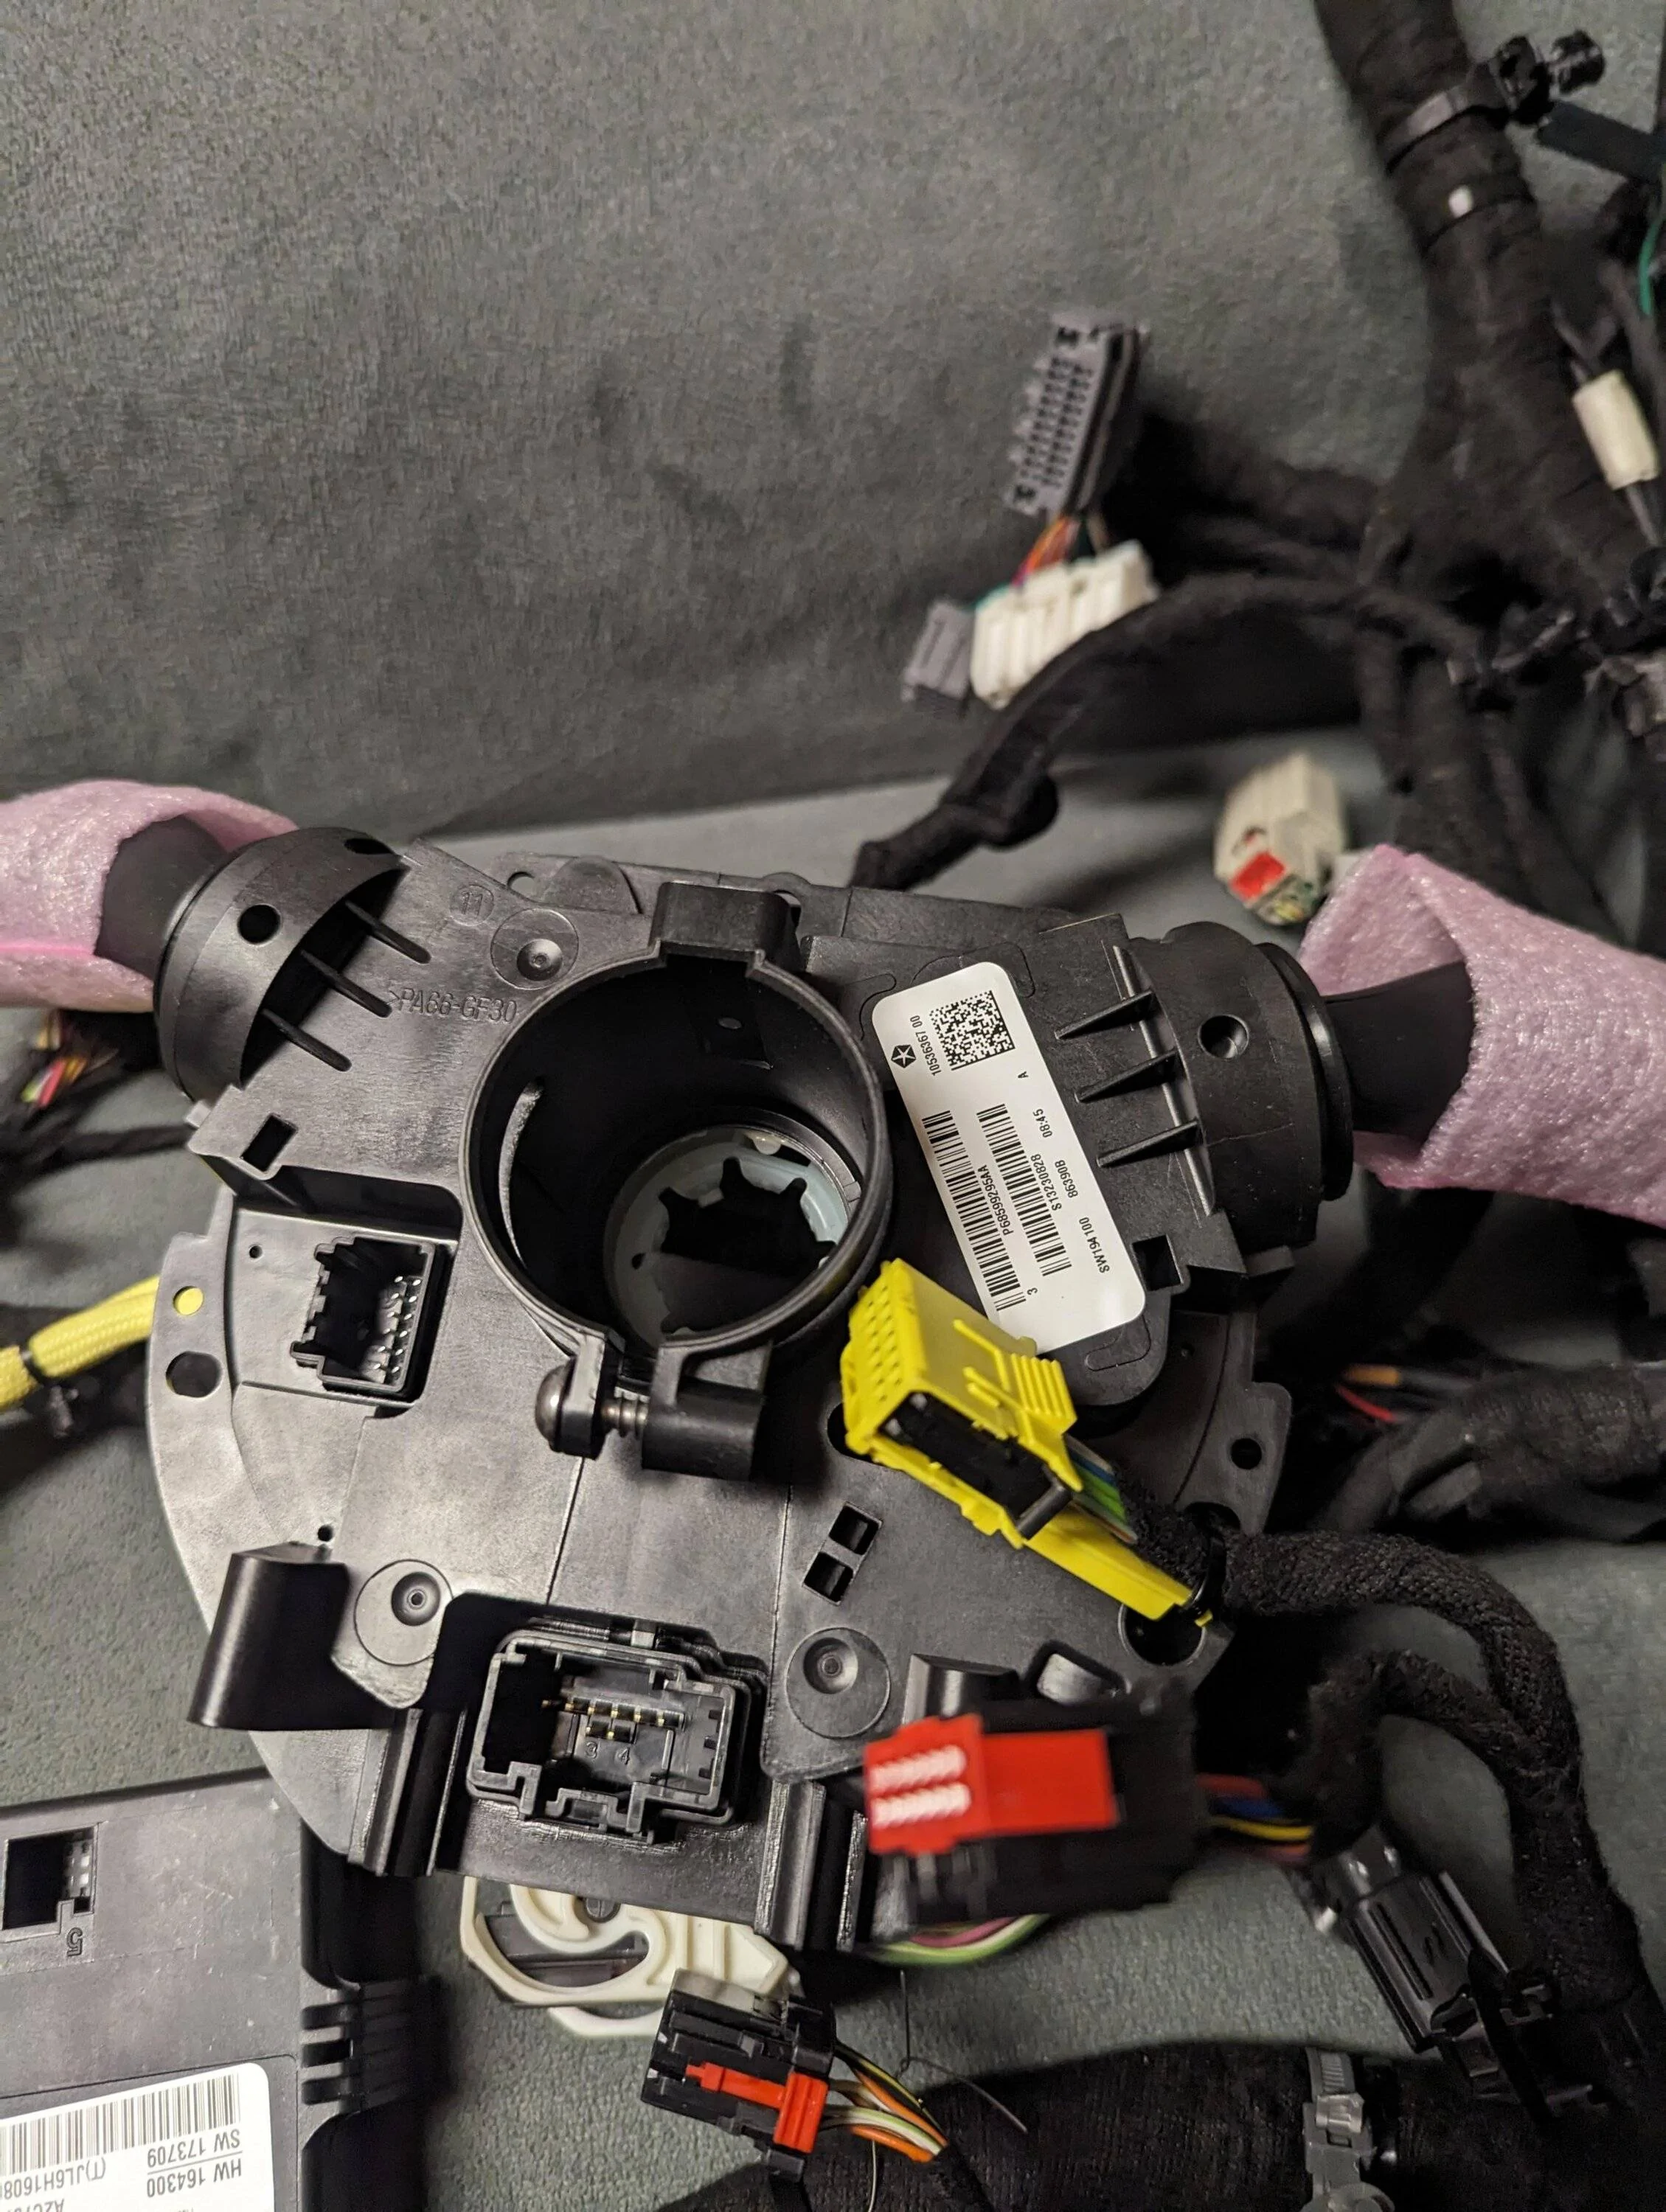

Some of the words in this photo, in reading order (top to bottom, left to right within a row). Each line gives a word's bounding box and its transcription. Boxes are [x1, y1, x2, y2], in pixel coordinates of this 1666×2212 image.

[909, 1015, 923, 1028] 00
[915, 1031, 942, 1077] 10536367
[1017, 1071, 1030, 1079] A
[1032, 1108, 1053, 1138] 08:45
[1030, 1154, 1062, 1211] S13230828
[1054, 1160, 1078, 1198] 86390B
[977, 1164, 1014, 1236] P68599295AA
[1027, 1287, 1038, 1295] 3
[585, 1741, 598, 1759] 3
[66, 1927, 83, 1958] 5
[147, 2137, 206, 2168] 173709
[214, 2128, 240, 2153] SW
[0, 2157, 106, 2200] (T)JL6H1608
[147, 2166, 206, 2198] 164300
[213, 2157, 242, 2183] HW
